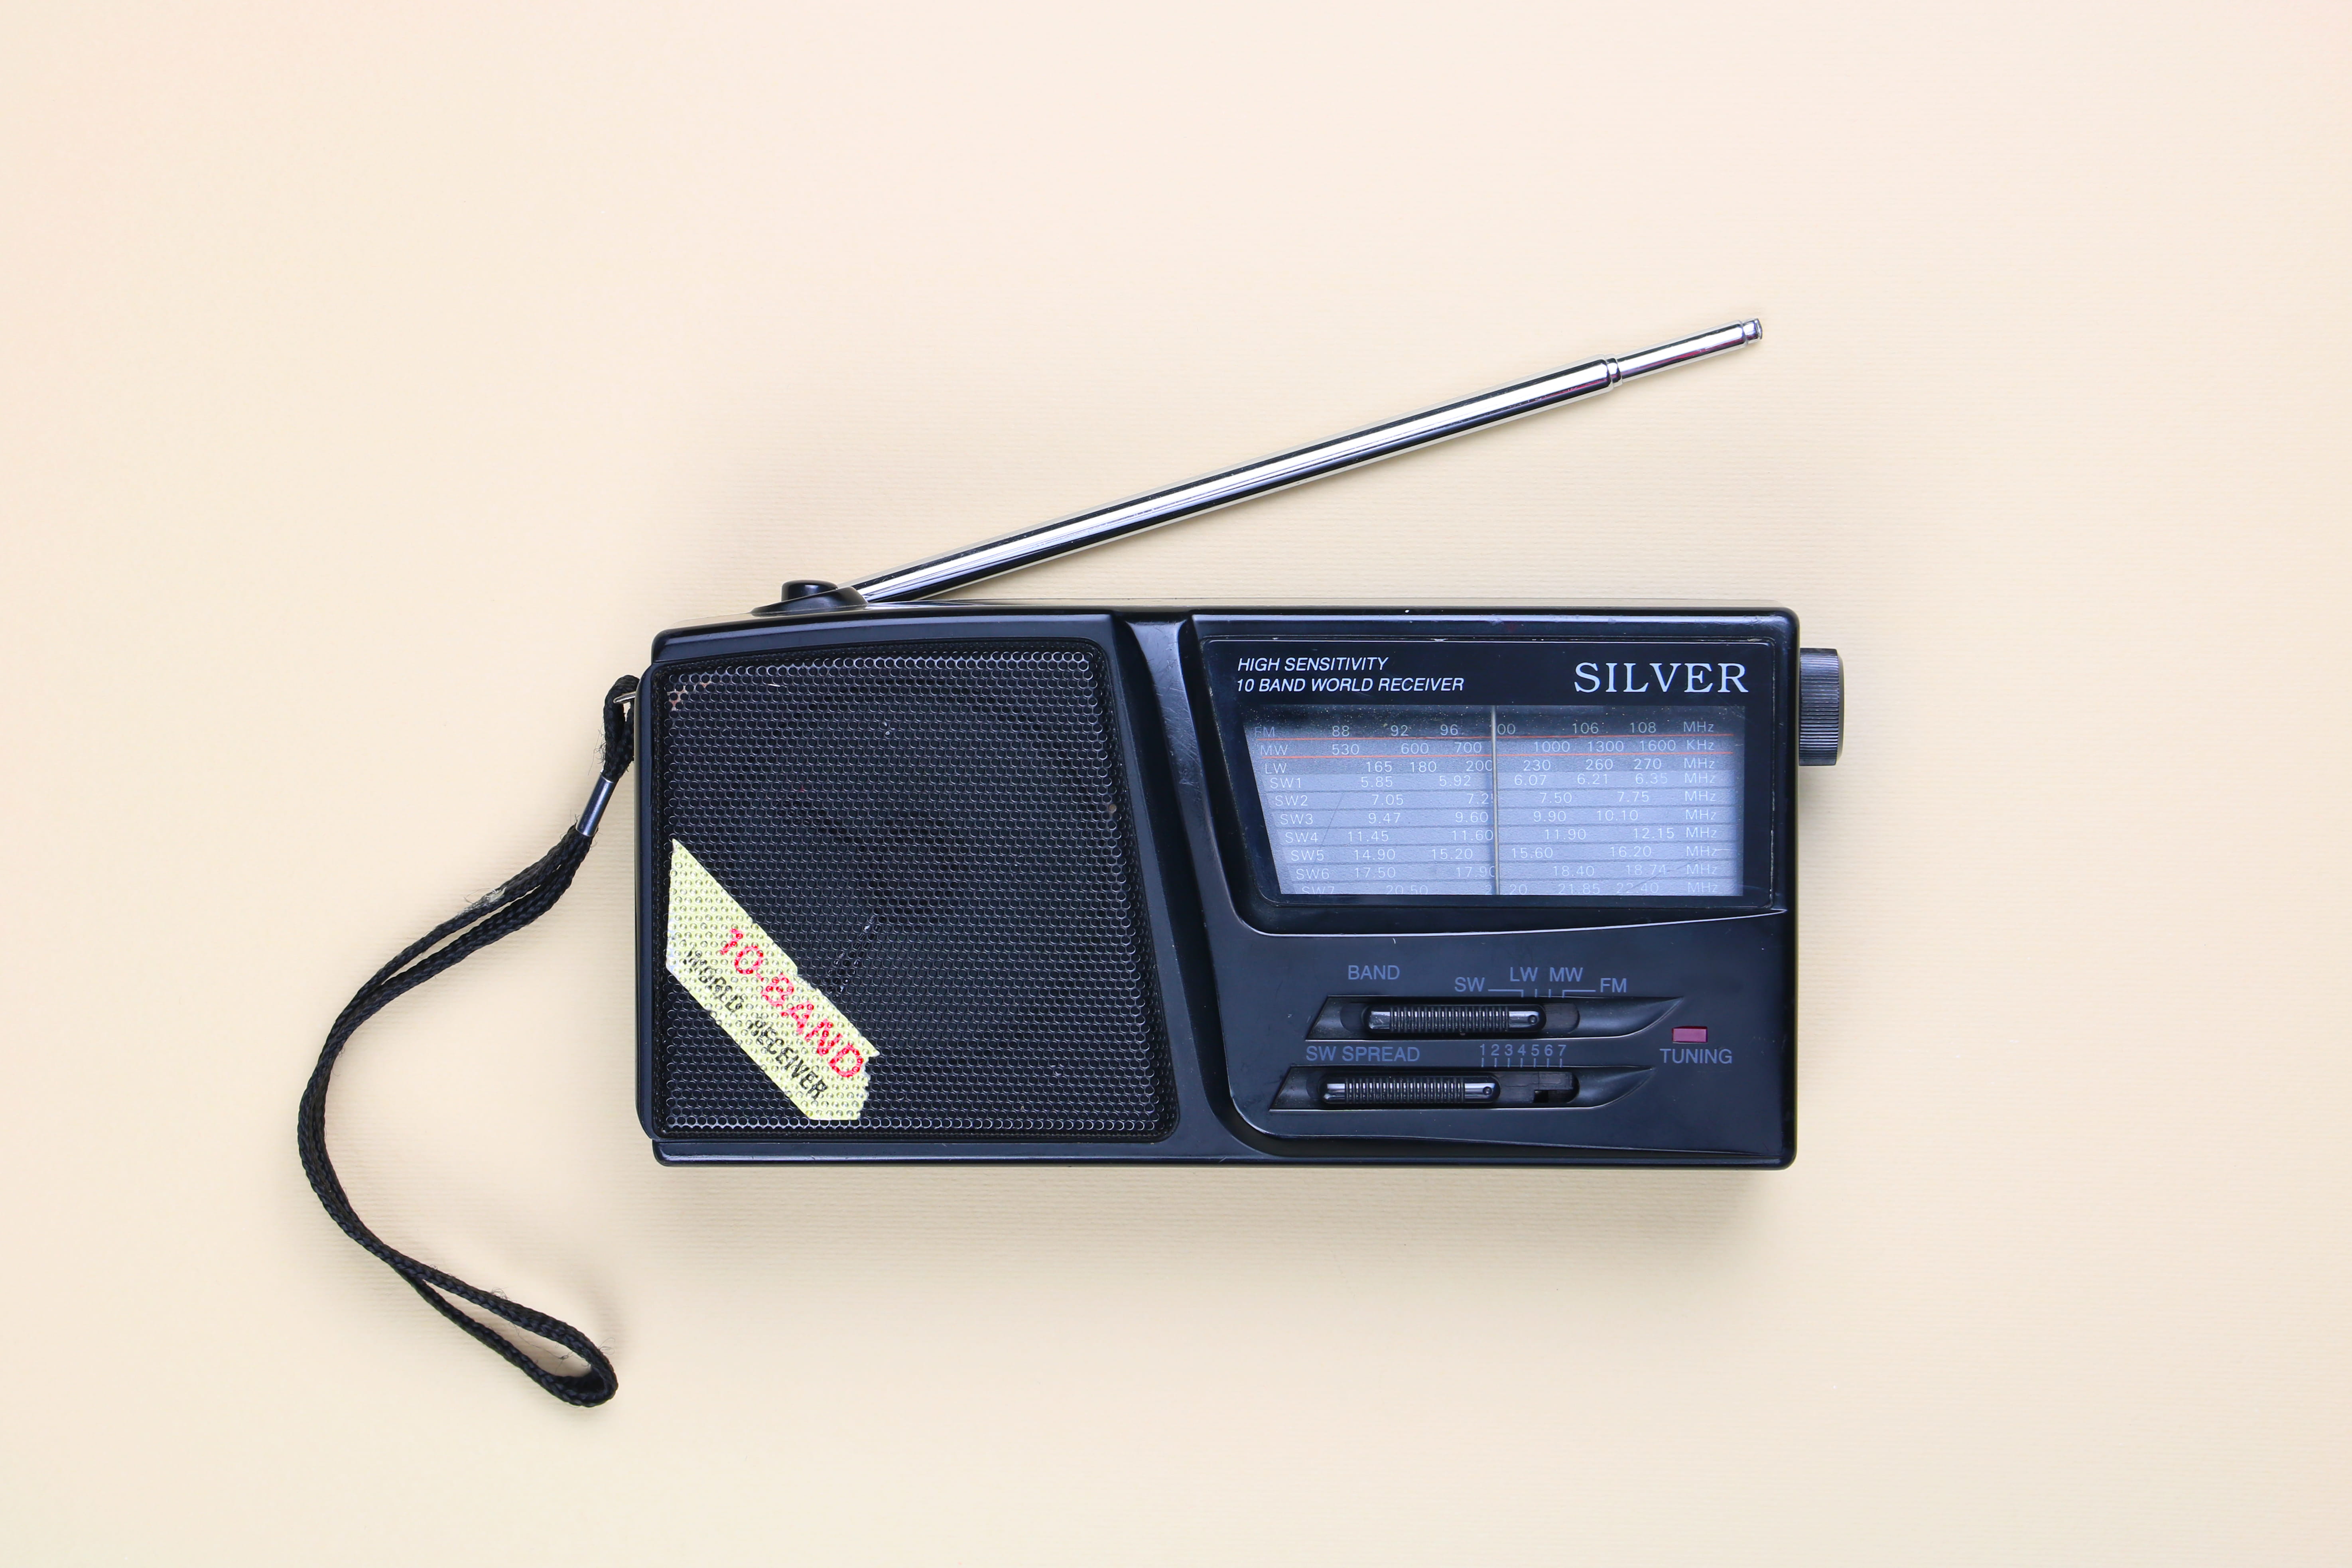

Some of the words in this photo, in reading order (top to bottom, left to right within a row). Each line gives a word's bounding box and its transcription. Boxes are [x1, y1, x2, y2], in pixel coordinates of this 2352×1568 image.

[1237, 658, 1280, 671] HIGH
[1284, 657, 1389, 671] SENSITIVITY
[1237, 678, 1254, 692] 10
[1259, 678, 1306, 691] BAND
[1311, 678, 1373, 691] WORLD
[1379, 678, 1464, 691] RECEIVER
[1574, 662, 1749, 693] SILVER
[1255, 726, 1275, 737] FM
[1332, 726, 1350, 737] 88
[1391, 725, 1408, 737] 92
[1440, 725, 1458, 735] 96
[1489, 723, 1515, 735] 00
[1572, 723, 1599, 734] 106
[1630, 722, 1656, 733] 108
[1684, 721, 1714, 732] MHz
[1261, 745, 1288, 755] MW
[1332, 744, 1359, 755] 530
[1401, 743, 1429, 754] 600
[1455, 742, 1482, 753] 700
[1534, 741, 1570, 752] 1000
[1588, 741, 1624, 752] 1300
[1640, 740, 1676, 751] 1600
[1686, 740, 1715, 750] KHz
[1265, 763, 1286, 774] LW
[1366, 761, 1392, 772] 165
[1410, 761, 1436, 772] 180
[1466, 760, 1492, 771] 200
[1523, 760, 1551, 771] 230
[1586, 759, 1613, 770] 260
[1634, 758, 1661, 769] 270
[1684, 758, 1715, 769] MHz
[1270, 778, 1302, 789] SW1
[1361, 776, 1393, 788] 5.85
[1439, 775, 1471, 786] 5.92
[1515, 775, 1546, 786] 6.07
[1577, 774, 1608, 785] 6.21
[1636, 773, 1667, 784] 6.35
[1684, 773, 1715, 783] MHz
[1275, 795, 1308, 806] SW2
[1372, 794, 1403, 806] 7.05
[1540, 792, 1572, 804] 7.50
[1617, 792, 1649, 802] 7.75
[1685, 791, 1716, 801] MHz
[1280, 814, 1313, 825] SW3
[1369, 813, 1401, 824] 9.47
[1455, 812, 1488, 823] 9.60
[1533, 811, 1566, 822] 9.90
[1596, 810, 1638, 821] 10.10
[1686, 810, 1716, 820] MHz
[1285, 832, 1318, 843] SW4
[1347, 831, 1389, 842] 11.45
[1452, 829, 1493, 841] 11.60
[1544, 829, 1586, 840] 11.90
[1633, 827, 1674, 839] 12.15
[1686, 827, 1717, 838] MHz
[1291, 850, 1324, 861] SW5
[1354, 849, 1395, 860] 14.90
[1431, 848, 1473, 859] 15.20
[1511, 847, 1553, 858] 15.60
[1610, 846, 1651, 857] 16.20
[1686, 845, 1717, 856] MHz
[1296, 868, 1329, 880] SW6
[1354, 867, 1396, 878] 17.50
[1553, 866, 1595, 877] 18.40
[1625, 864, 1666, 875] 18.74
[1686, 864, 1717, 875] MHz
[1485, 884, 1527, 895] 2.20
[1558, 883, 1600, 895] 21.85
[1616, 882, 1659, 894] 22.40
[1688, 882, 1718, 892] MHz
[1348, 965, 1400, 979] BAND
[1510, 967, 1538, 981] LW
[1550, 967, 1583, 981] MW
[1454, 977, 1485, 992] SW
[1600, 978, 1627, 992] FM
[719, 927, 864, 1078] 10-BAND
[1306, 1046, 1336, 1060] SW
[1342, 1046, 1420, 1061] SPREAD
[1480, 1044, 1485, 1056] 1
[1491, 1044, 1499, 1056] 2
[1505, 1044, 1513, 1056] 3
[1518, 1044, 1526, 1056] 4
[1531, 1044, 1539, 1056] 5
[1544, 1044, 1553, 1056] 6
[1558, 1044, 1566, 1056] 7
[1660, 1048, 1732, 1063] TUNING
